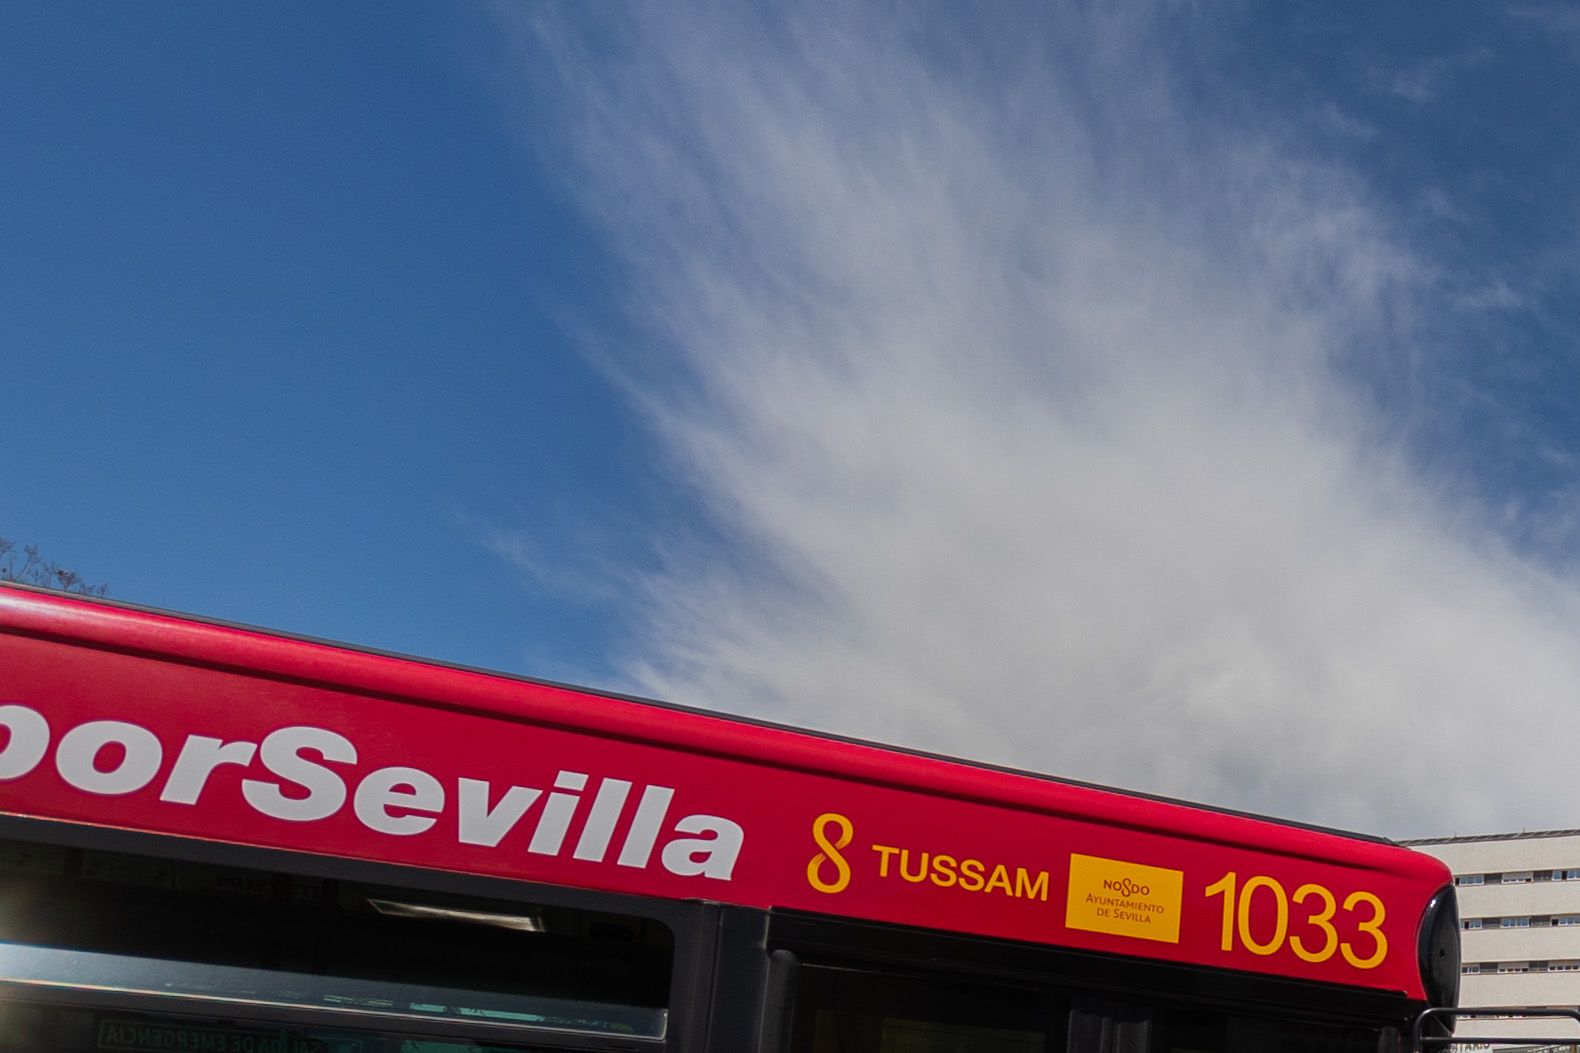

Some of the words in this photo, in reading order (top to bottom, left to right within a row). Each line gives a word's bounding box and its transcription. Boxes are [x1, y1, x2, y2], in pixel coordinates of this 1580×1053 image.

[871, 844, 1049, 902] TUSSAM
[1097, 908, 1110, 917] DE
[1204, 871, 1389, 970] 1033
